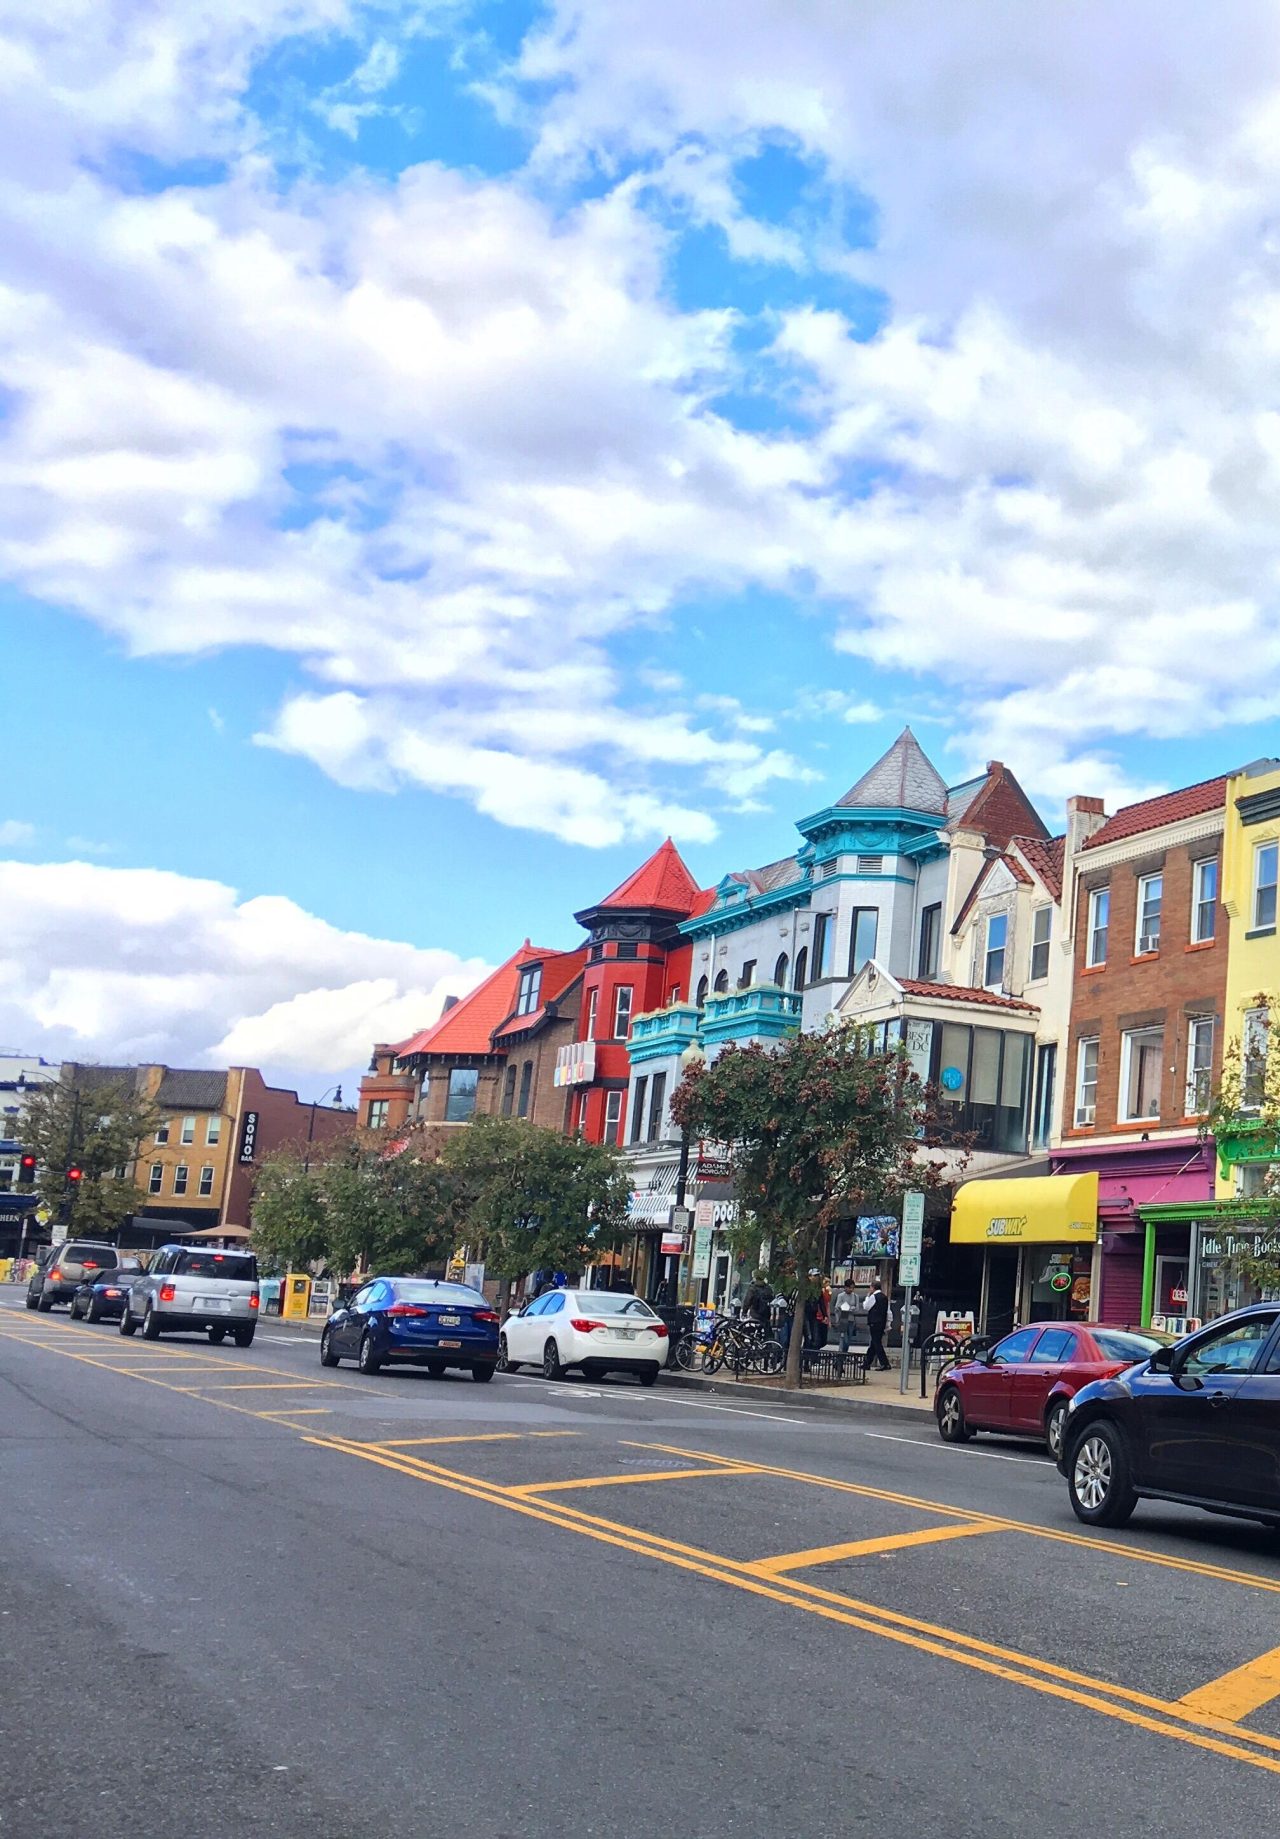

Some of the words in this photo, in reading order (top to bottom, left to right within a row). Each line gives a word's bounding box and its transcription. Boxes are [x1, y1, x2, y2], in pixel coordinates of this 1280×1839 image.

[243, 1113, 256, 1155] SOHO
[986, 1216, 1028, 1237] SUBWAY
[1201, 1236, 1222, 1258] Idle
[944, 1321, 971, 1331] SUBWAY
